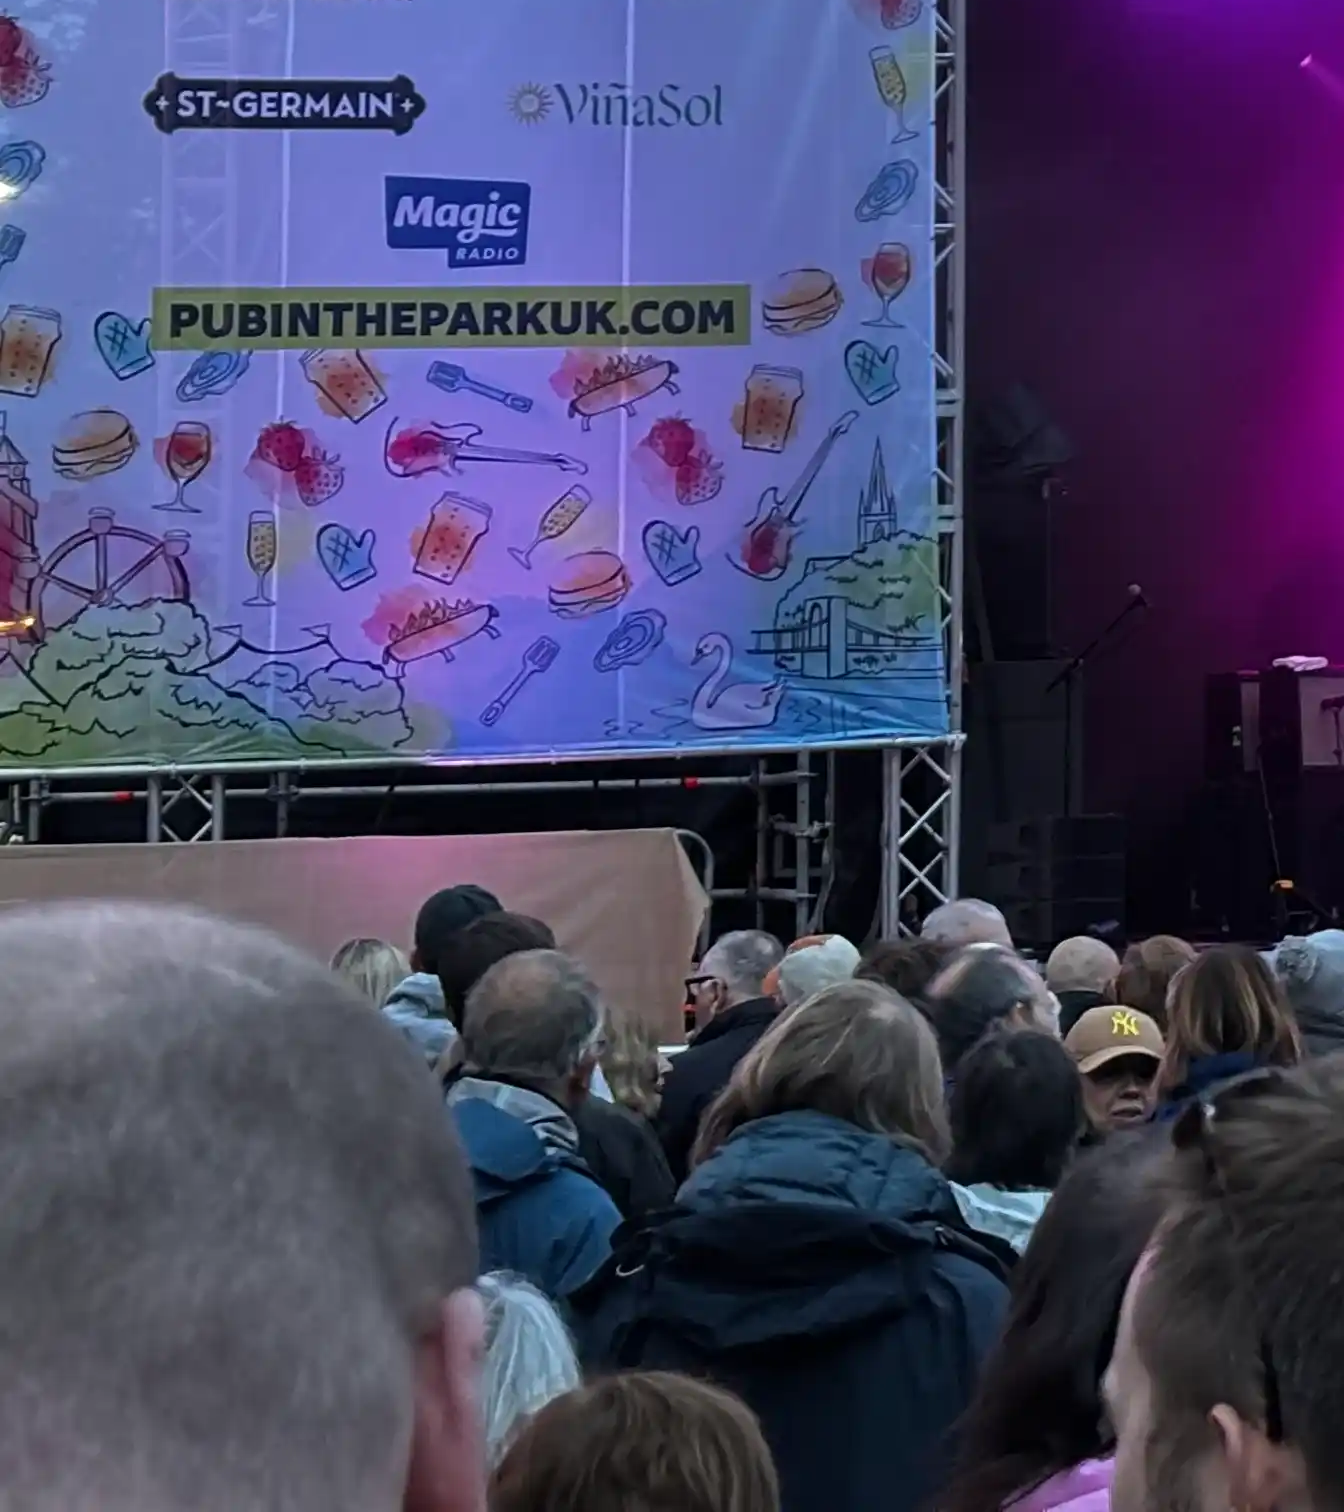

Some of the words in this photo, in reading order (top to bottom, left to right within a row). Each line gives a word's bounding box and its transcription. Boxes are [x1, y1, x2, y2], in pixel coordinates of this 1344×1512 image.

[393, 190, 521, 244] Magic
[456, 248, 519, 260] RADIO
[170, 300, 734, 338] PUBINTHEPARKUK.COM
